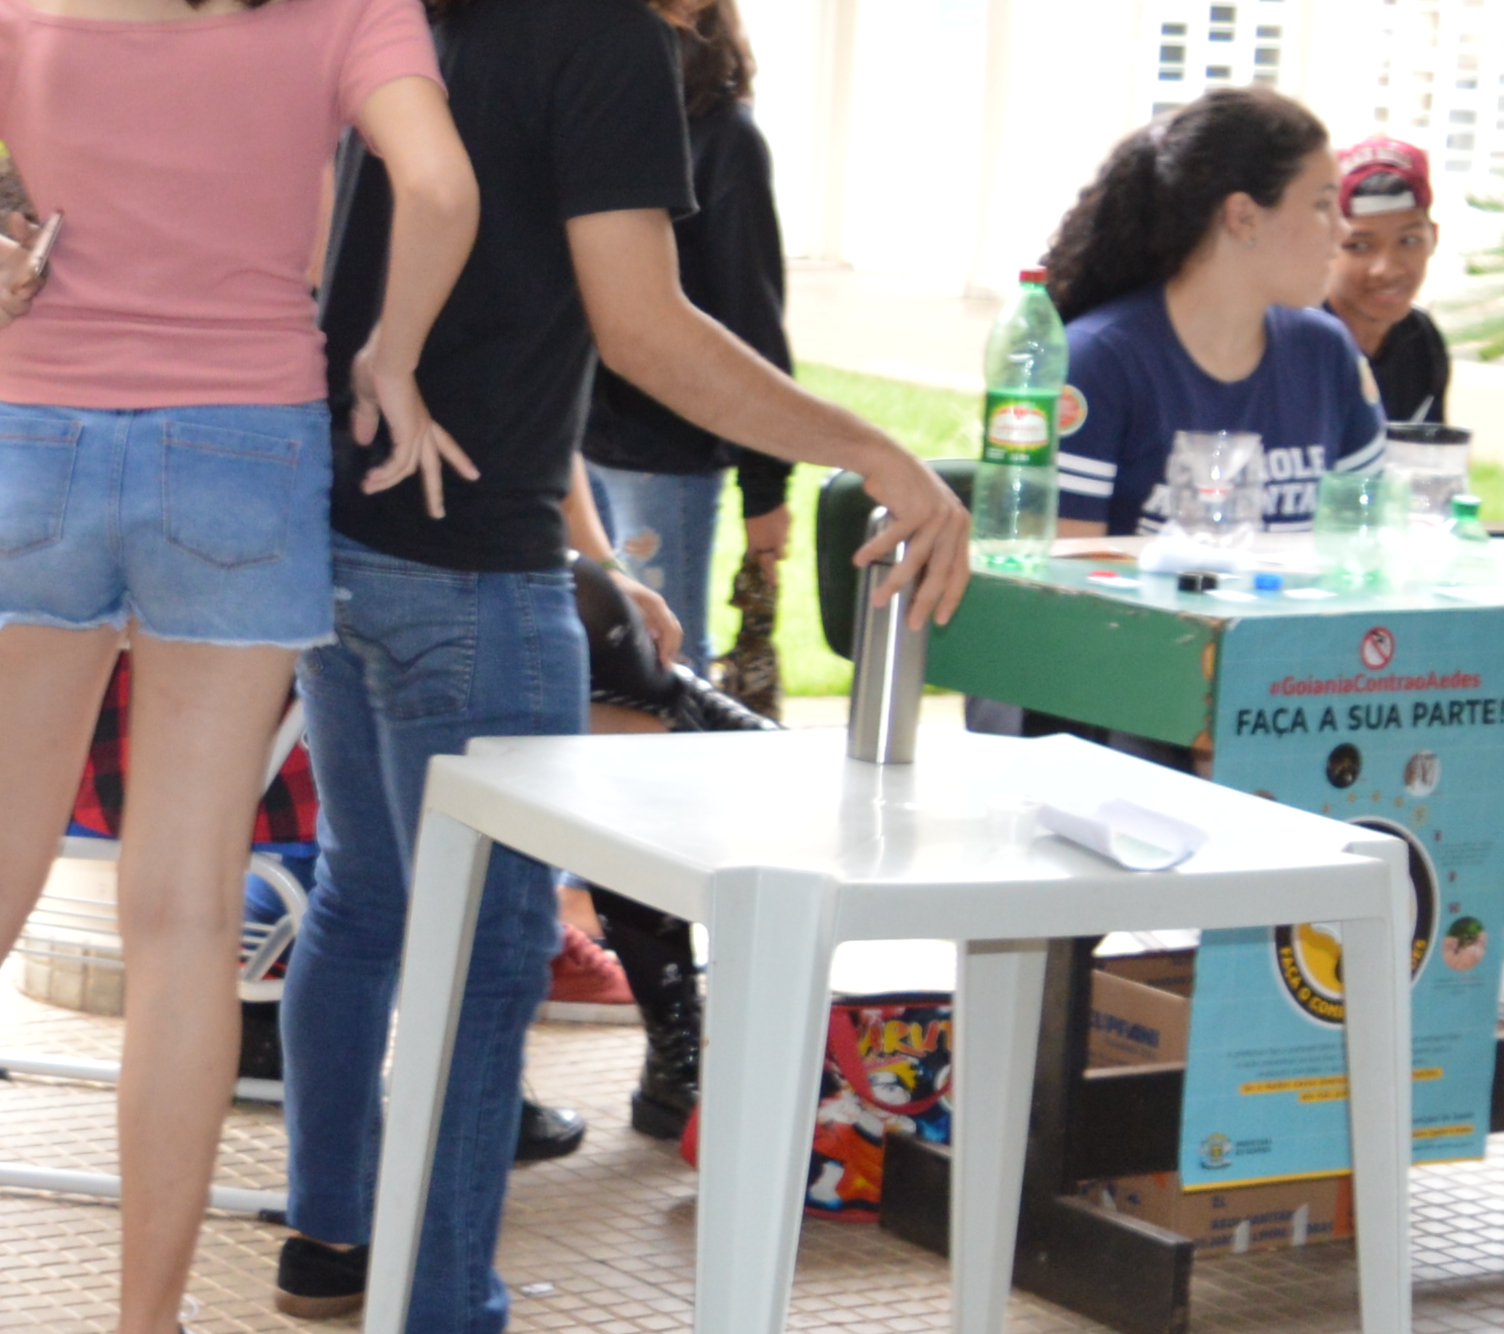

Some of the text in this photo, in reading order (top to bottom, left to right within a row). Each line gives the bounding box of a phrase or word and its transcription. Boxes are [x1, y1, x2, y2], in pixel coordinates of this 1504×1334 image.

[1235, 705, 1308, 739] FAÇA
[1318, 706, 1339, 732] A
[1348, 701, 1404, 731] SUA
